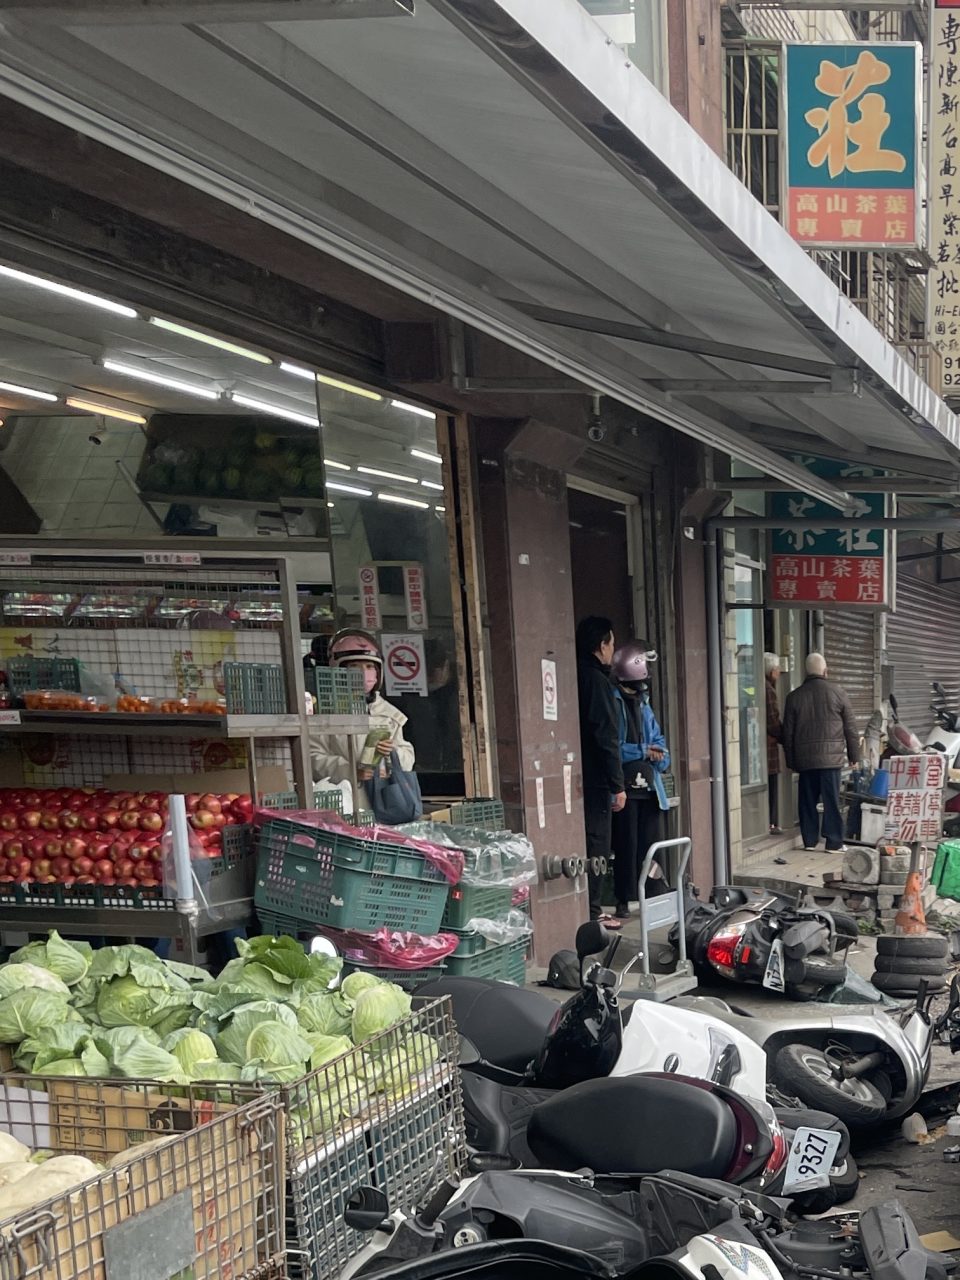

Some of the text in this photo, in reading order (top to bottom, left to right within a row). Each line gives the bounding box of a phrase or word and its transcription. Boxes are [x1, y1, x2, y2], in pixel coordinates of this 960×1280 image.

[804, 50, 906, 179] 莊
[796, 193, 907, 214] 高山茶葉
[796, 217, 908, 239] 專賣店
[776, 557, 880, 579] 高山茶葉
[776, 579, 880, 601] 專賣店
